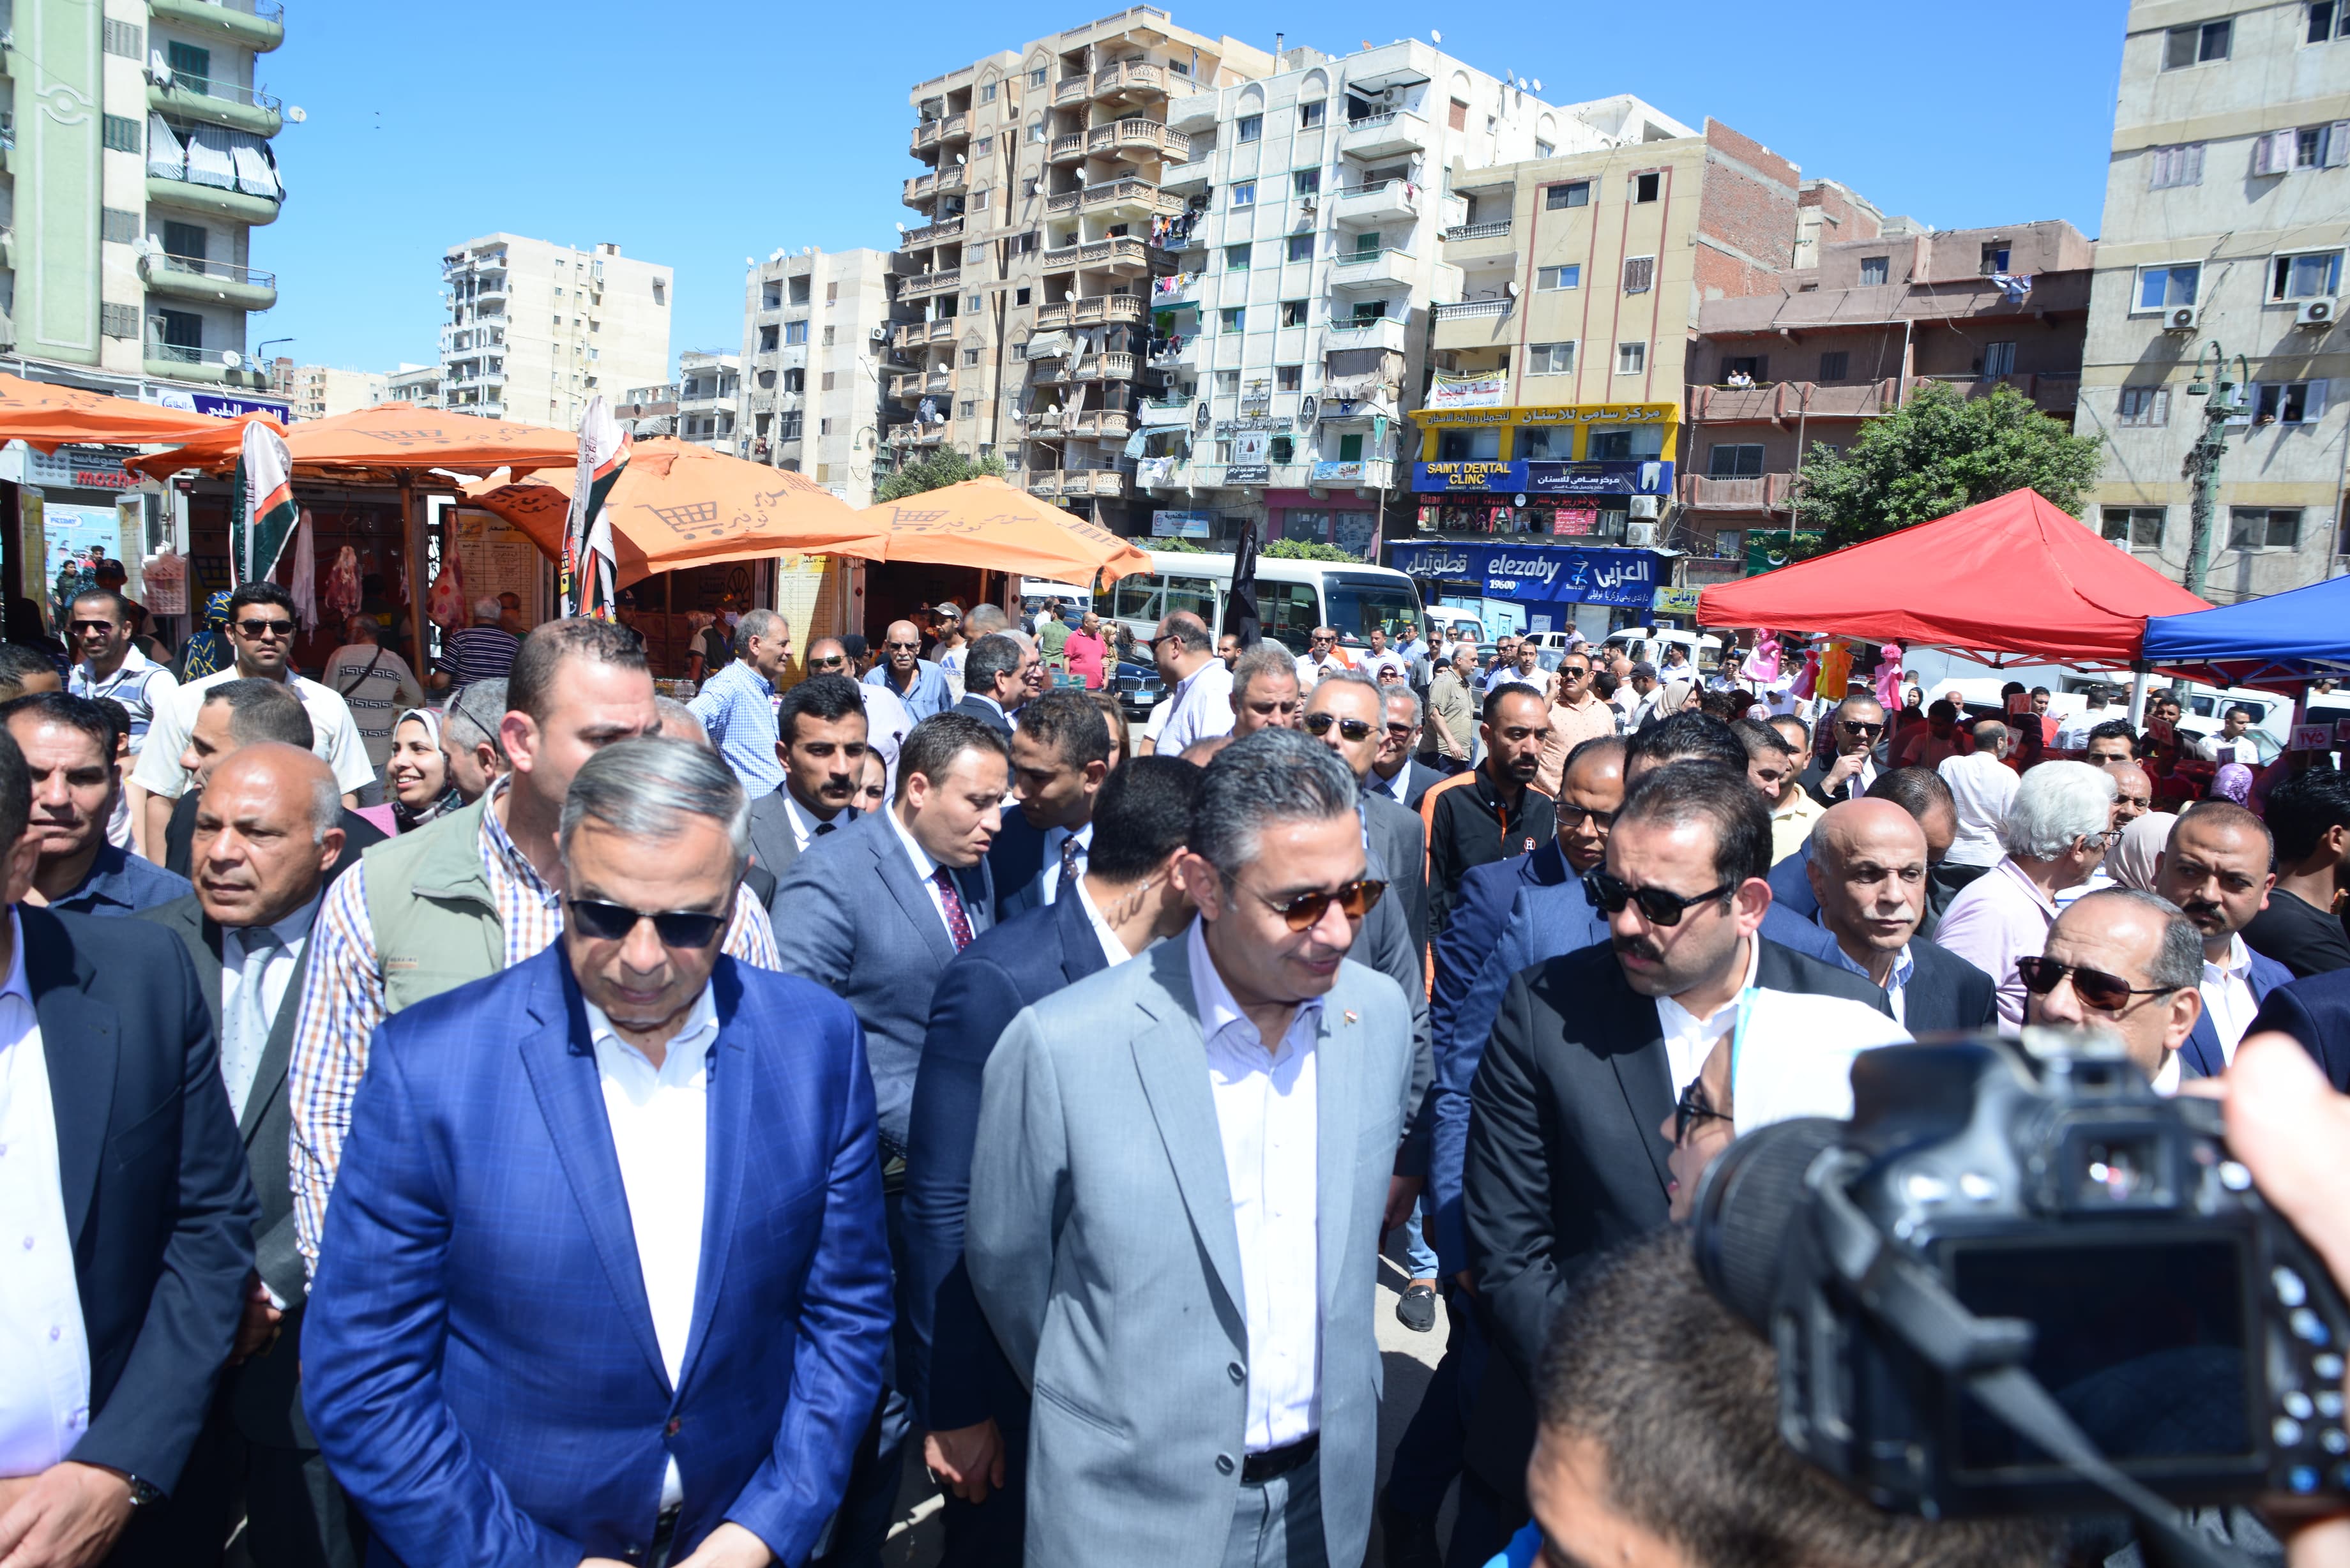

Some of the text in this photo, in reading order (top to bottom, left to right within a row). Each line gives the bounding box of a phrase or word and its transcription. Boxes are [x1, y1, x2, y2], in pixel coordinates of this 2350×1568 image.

[1436, 379, 1501, 402] شقة للبيع
[1522, 407, 1577, 423] للاسنان
[1579, 409, 1619, 422] سامى
[1622, 407, 1660, 422] مركز
[1427, 463, 1512, 474] SAMY DENTAL
[1449, 474, 1486, 485] CLINC
[1570, 476, 1598, 485] سامى
[1598, 476, 1620, 485] مركز
[1406, 553, 1468, 578] قطونيل
[1488, 554, 1561, 584] elezaby
[1489, 579, 1517, 590] 19600
[1526, 840, 1533, 850] H
